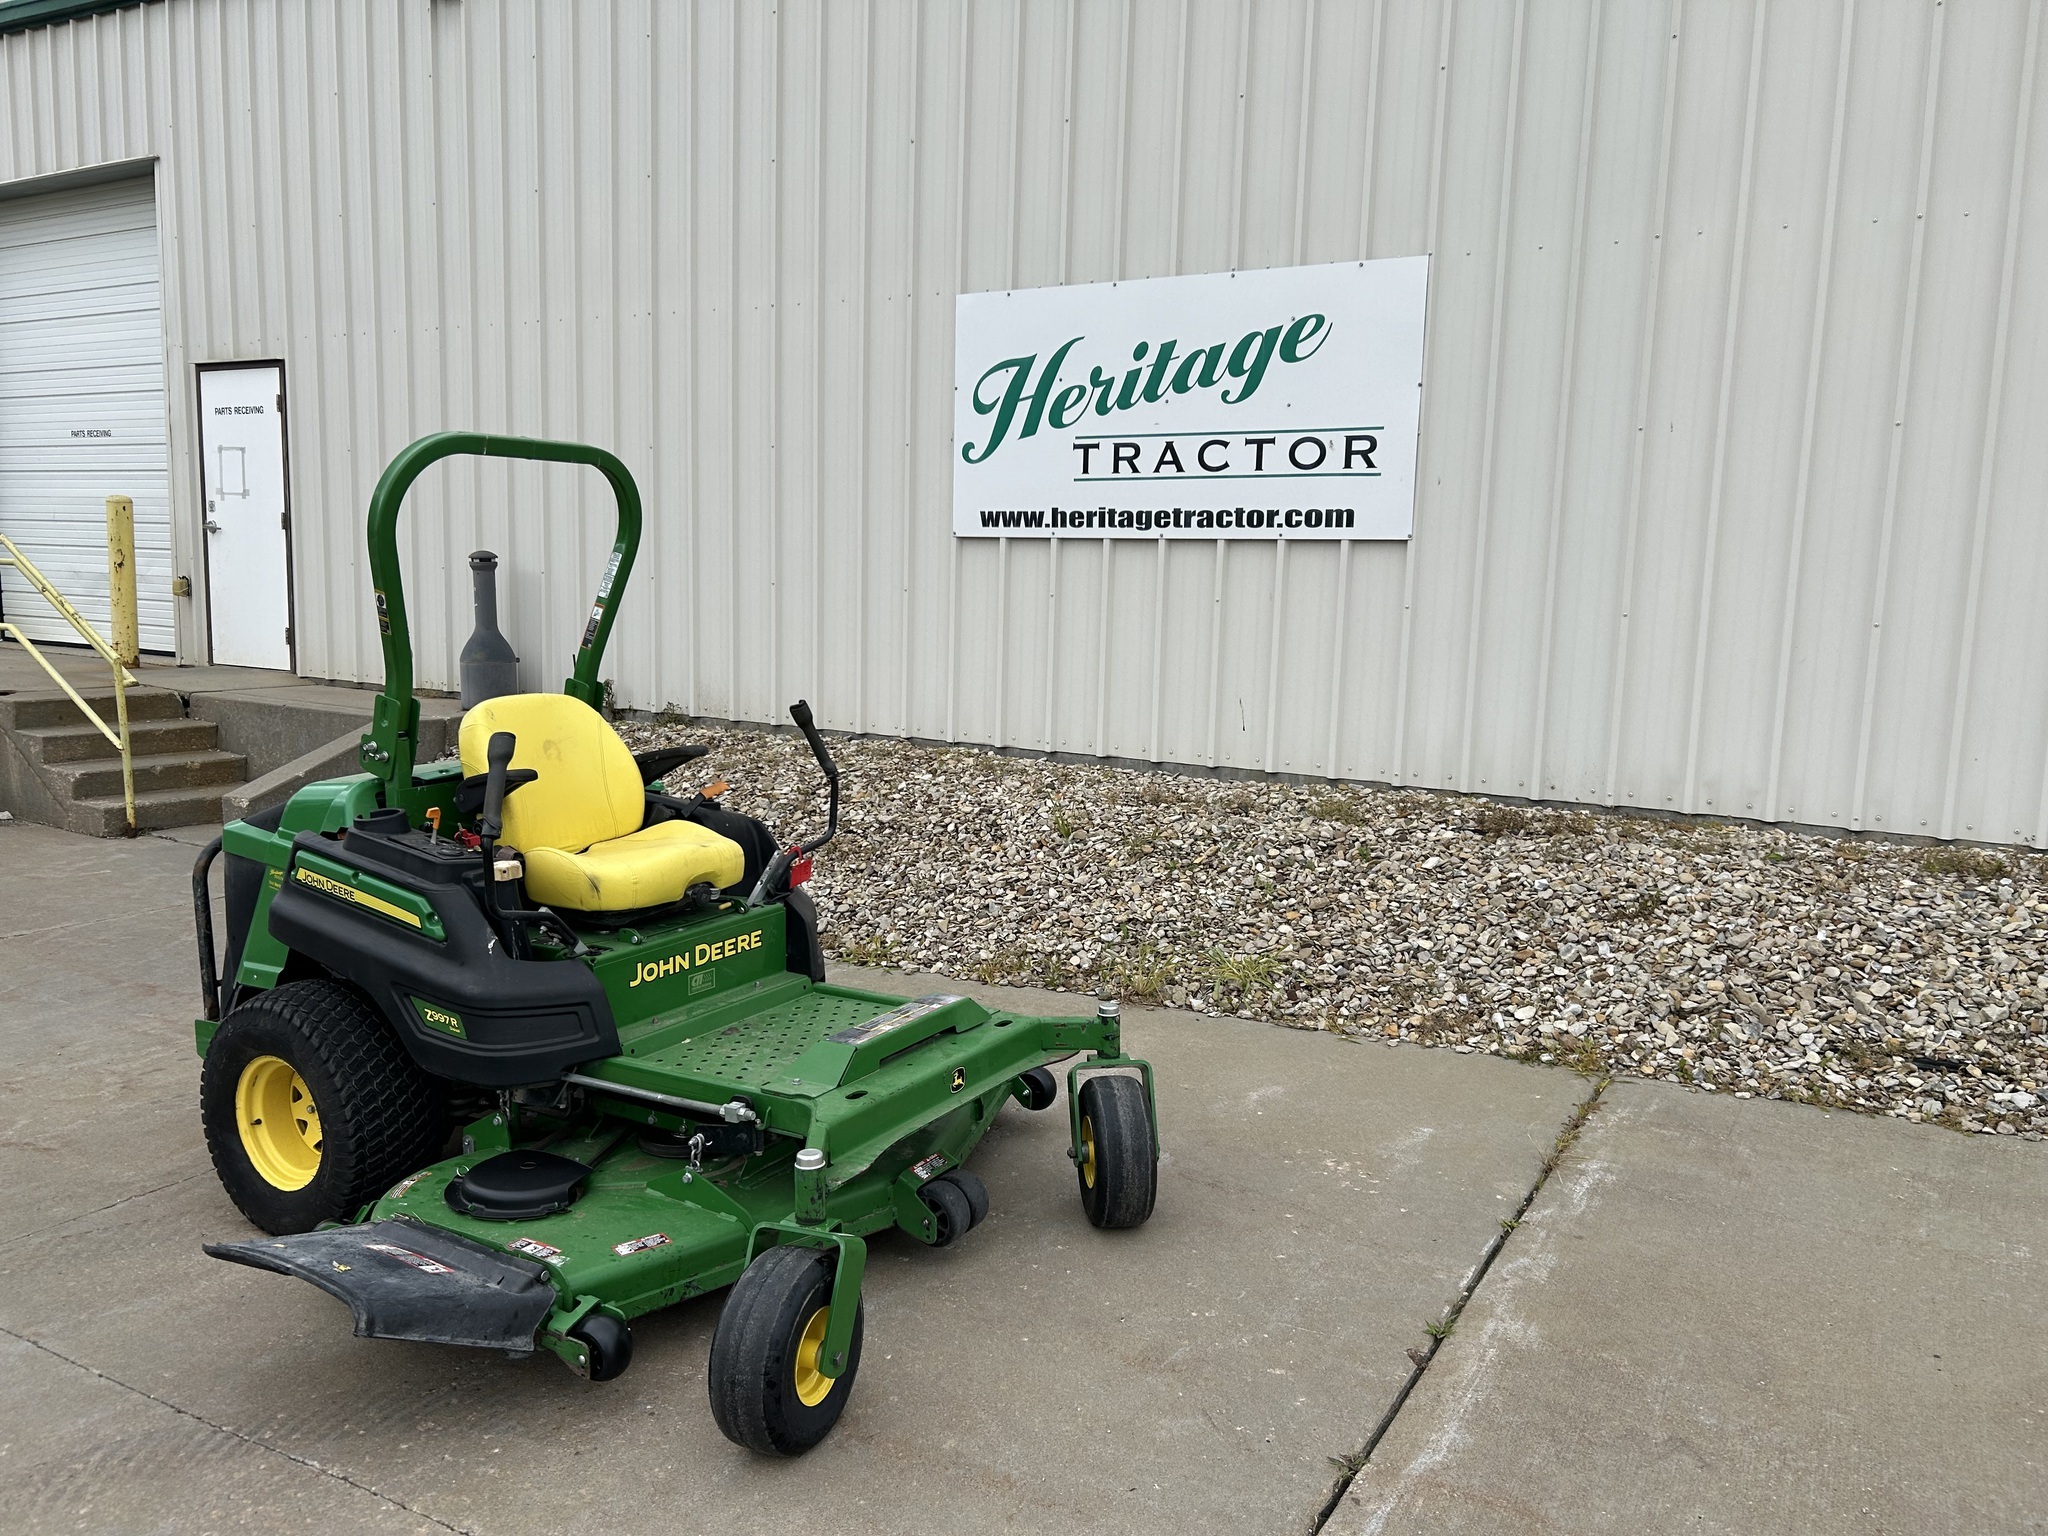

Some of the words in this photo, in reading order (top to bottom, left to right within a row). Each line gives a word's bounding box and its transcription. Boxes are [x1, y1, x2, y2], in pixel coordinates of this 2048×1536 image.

[961, 313, 1333, 464] Heritage
[214, 407, 233, 416] PARTS
[234, 405, 264, 415] RECEIVING
[70, 430, 86, 438] PARTS
[87, 429, 112, 438] RECEIVING
[1073, 434, 1379, 474] TRACTOR
[980, 506, 1355, 531] www.heritagetractor.com
[301, 871, 325, 889] JOHN
[325, 879, 356, 902] DEERE
[629, 951, 690, 988] JOHN
[694, 929, 763, 967] DEERE
